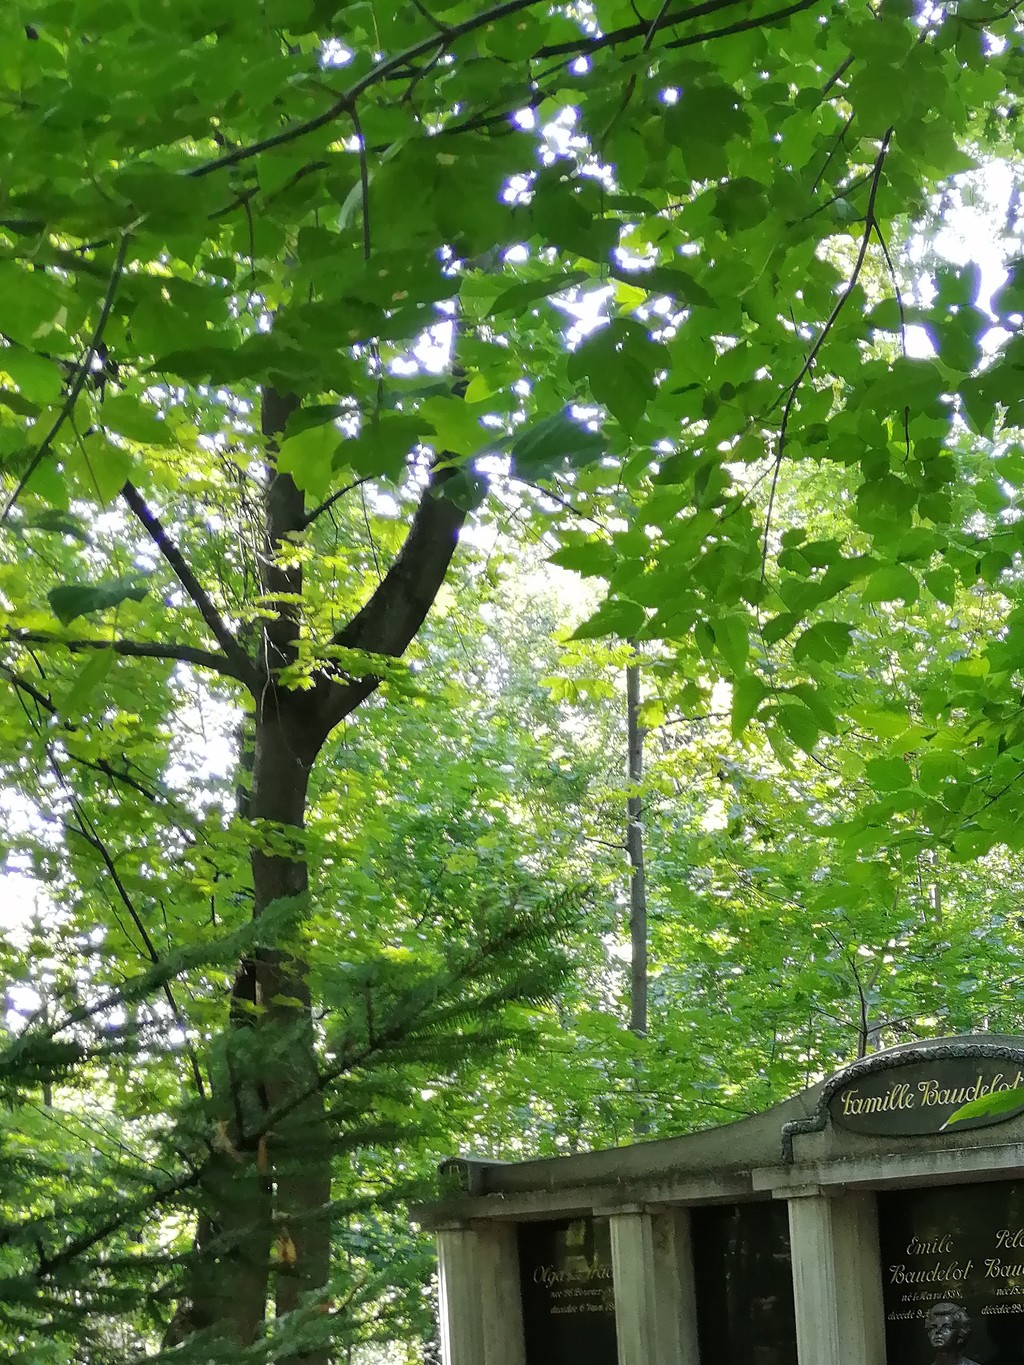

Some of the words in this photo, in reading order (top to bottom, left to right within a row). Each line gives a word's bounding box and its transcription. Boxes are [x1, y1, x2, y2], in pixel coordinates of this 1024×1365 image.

[841, 1083, 915, 1116] Famille
[918, 1071, 1024, 1107] Baudelot
[889, 1259, 974, 1285] Baudelot
